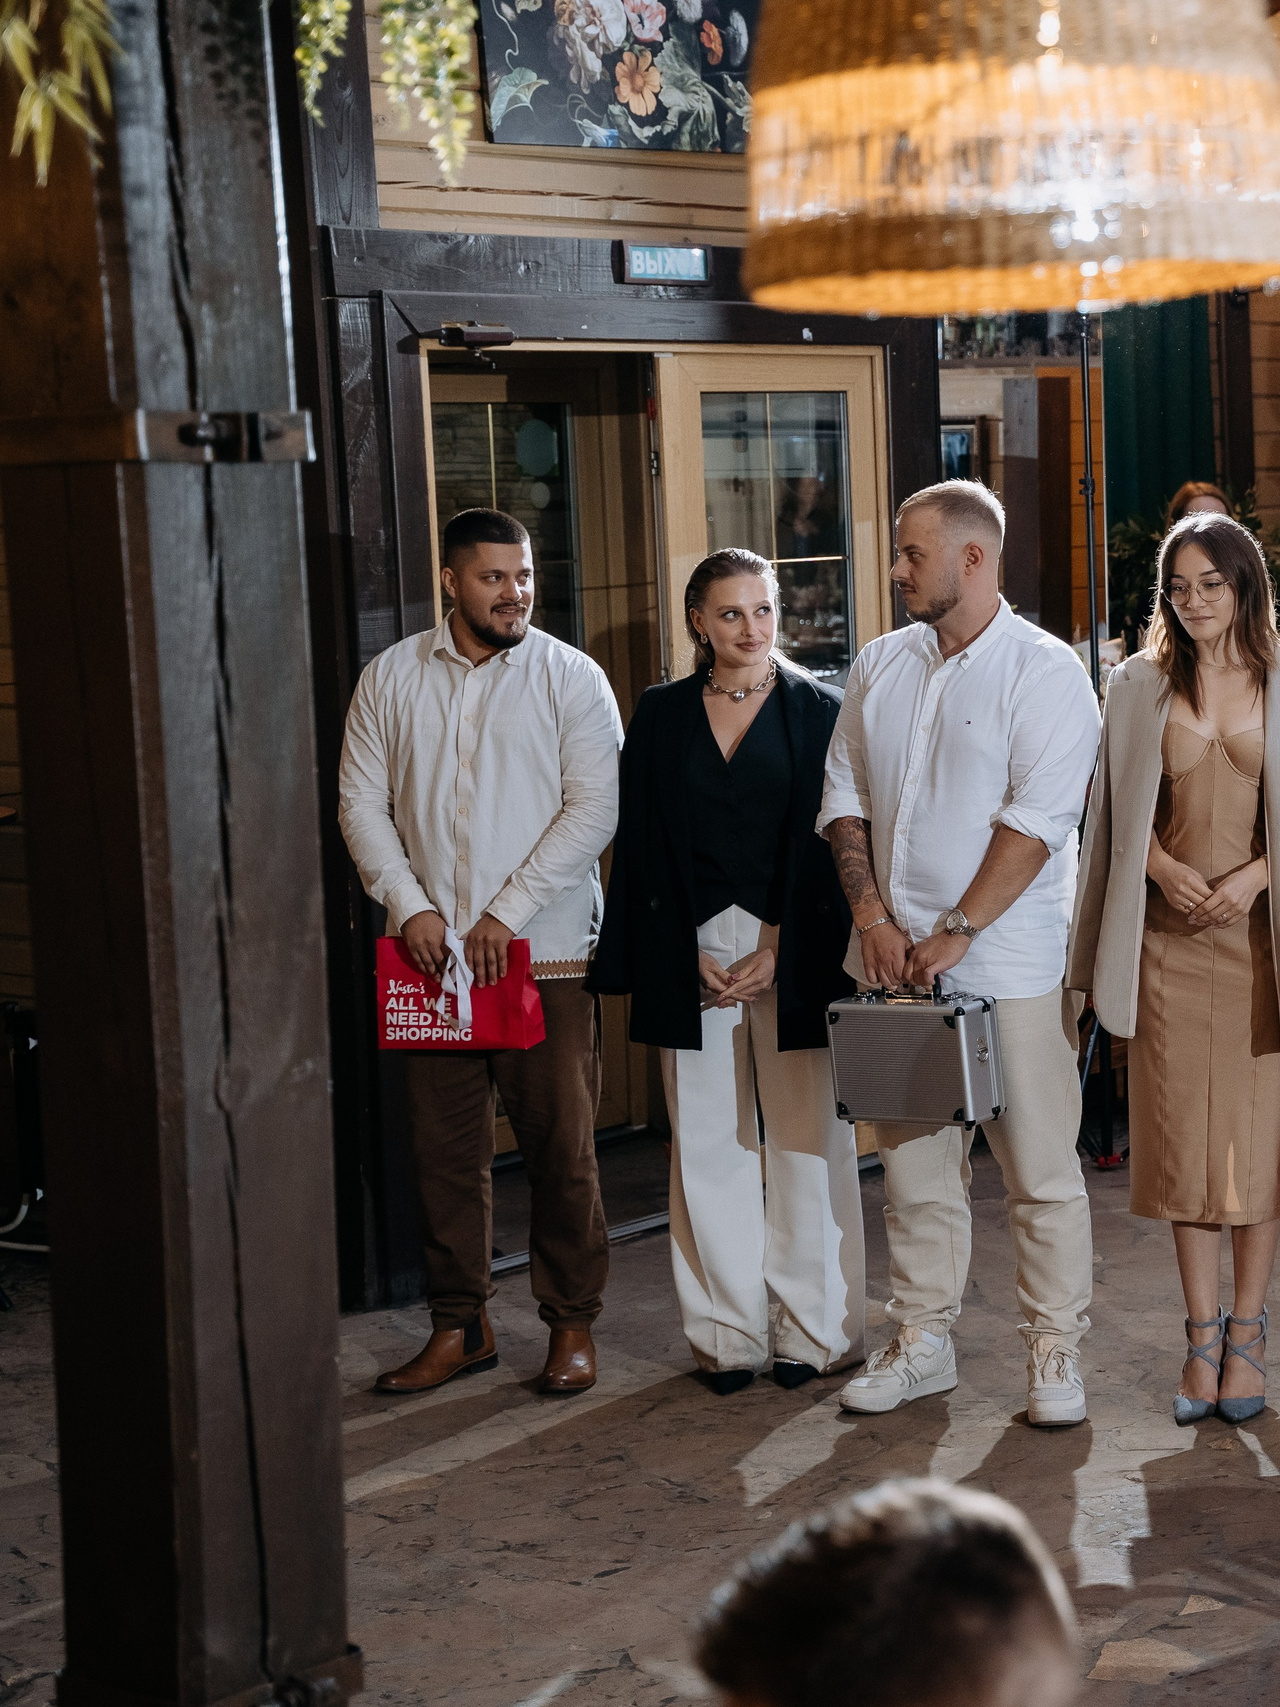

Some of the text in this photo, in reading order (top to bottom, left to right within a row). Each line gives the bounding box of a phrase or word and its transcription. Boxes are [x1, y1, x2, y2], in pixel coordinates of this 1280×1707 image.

[385, 997, 418, 1010] ALL
[385, 1012, 433, 1026] NEED
[385, 1027, 472, 1041] SHOPPING
